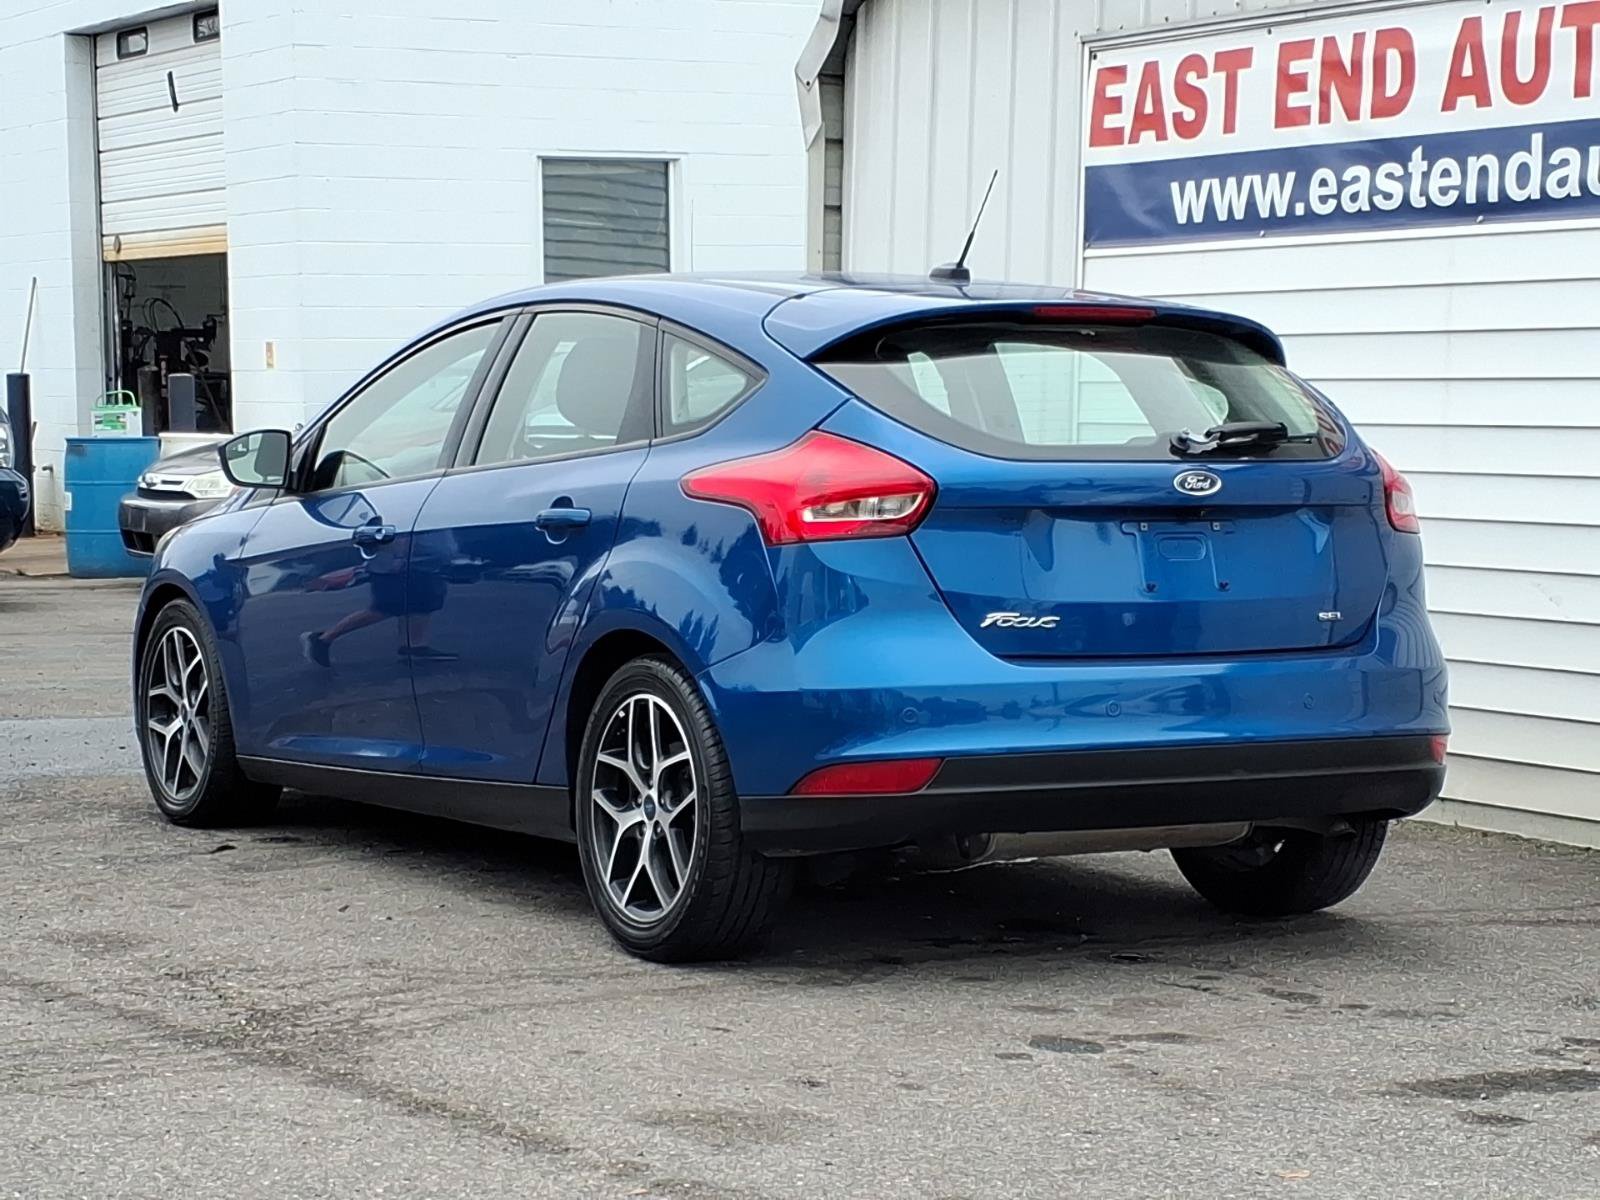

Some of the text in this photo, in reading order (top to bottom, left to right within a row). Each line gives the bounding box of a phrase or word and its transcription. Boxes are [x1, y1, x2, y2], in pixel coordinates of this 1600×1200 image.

[1089, 1, 1600, 148] EAST END AUT
[1185, 475, 1211, 489] Ford
